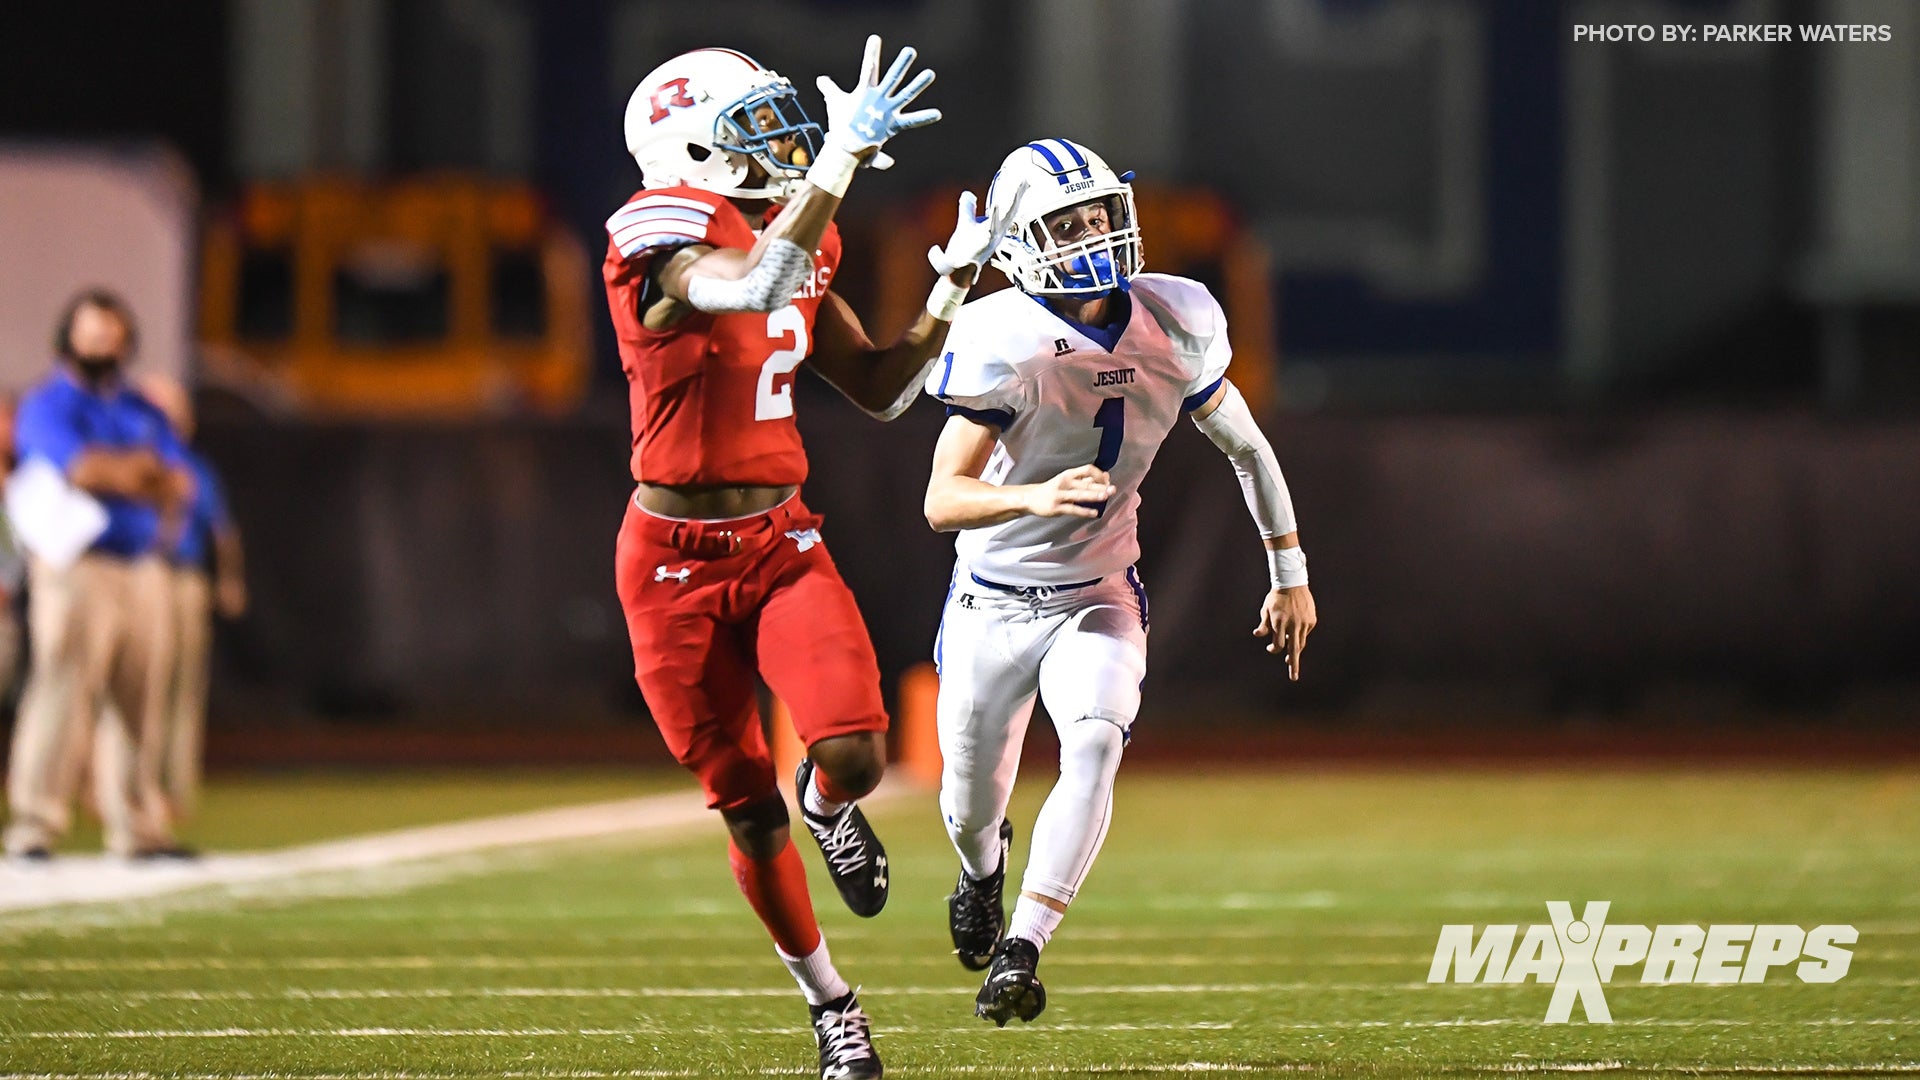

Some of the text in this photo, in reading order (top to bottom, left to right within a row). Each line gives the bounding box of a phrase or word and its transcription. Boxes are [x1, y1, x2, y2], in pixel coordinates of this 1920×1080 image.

[649, 77, 696, 125] R
[1064, 179, 1096, 195] JESUIT
[754, 304, 809, 422] 2
[938, 351, 955, 398] 1
[1093, 367, 1136, 388] JESUIT
[1090, 396, 1125, 518] 1
